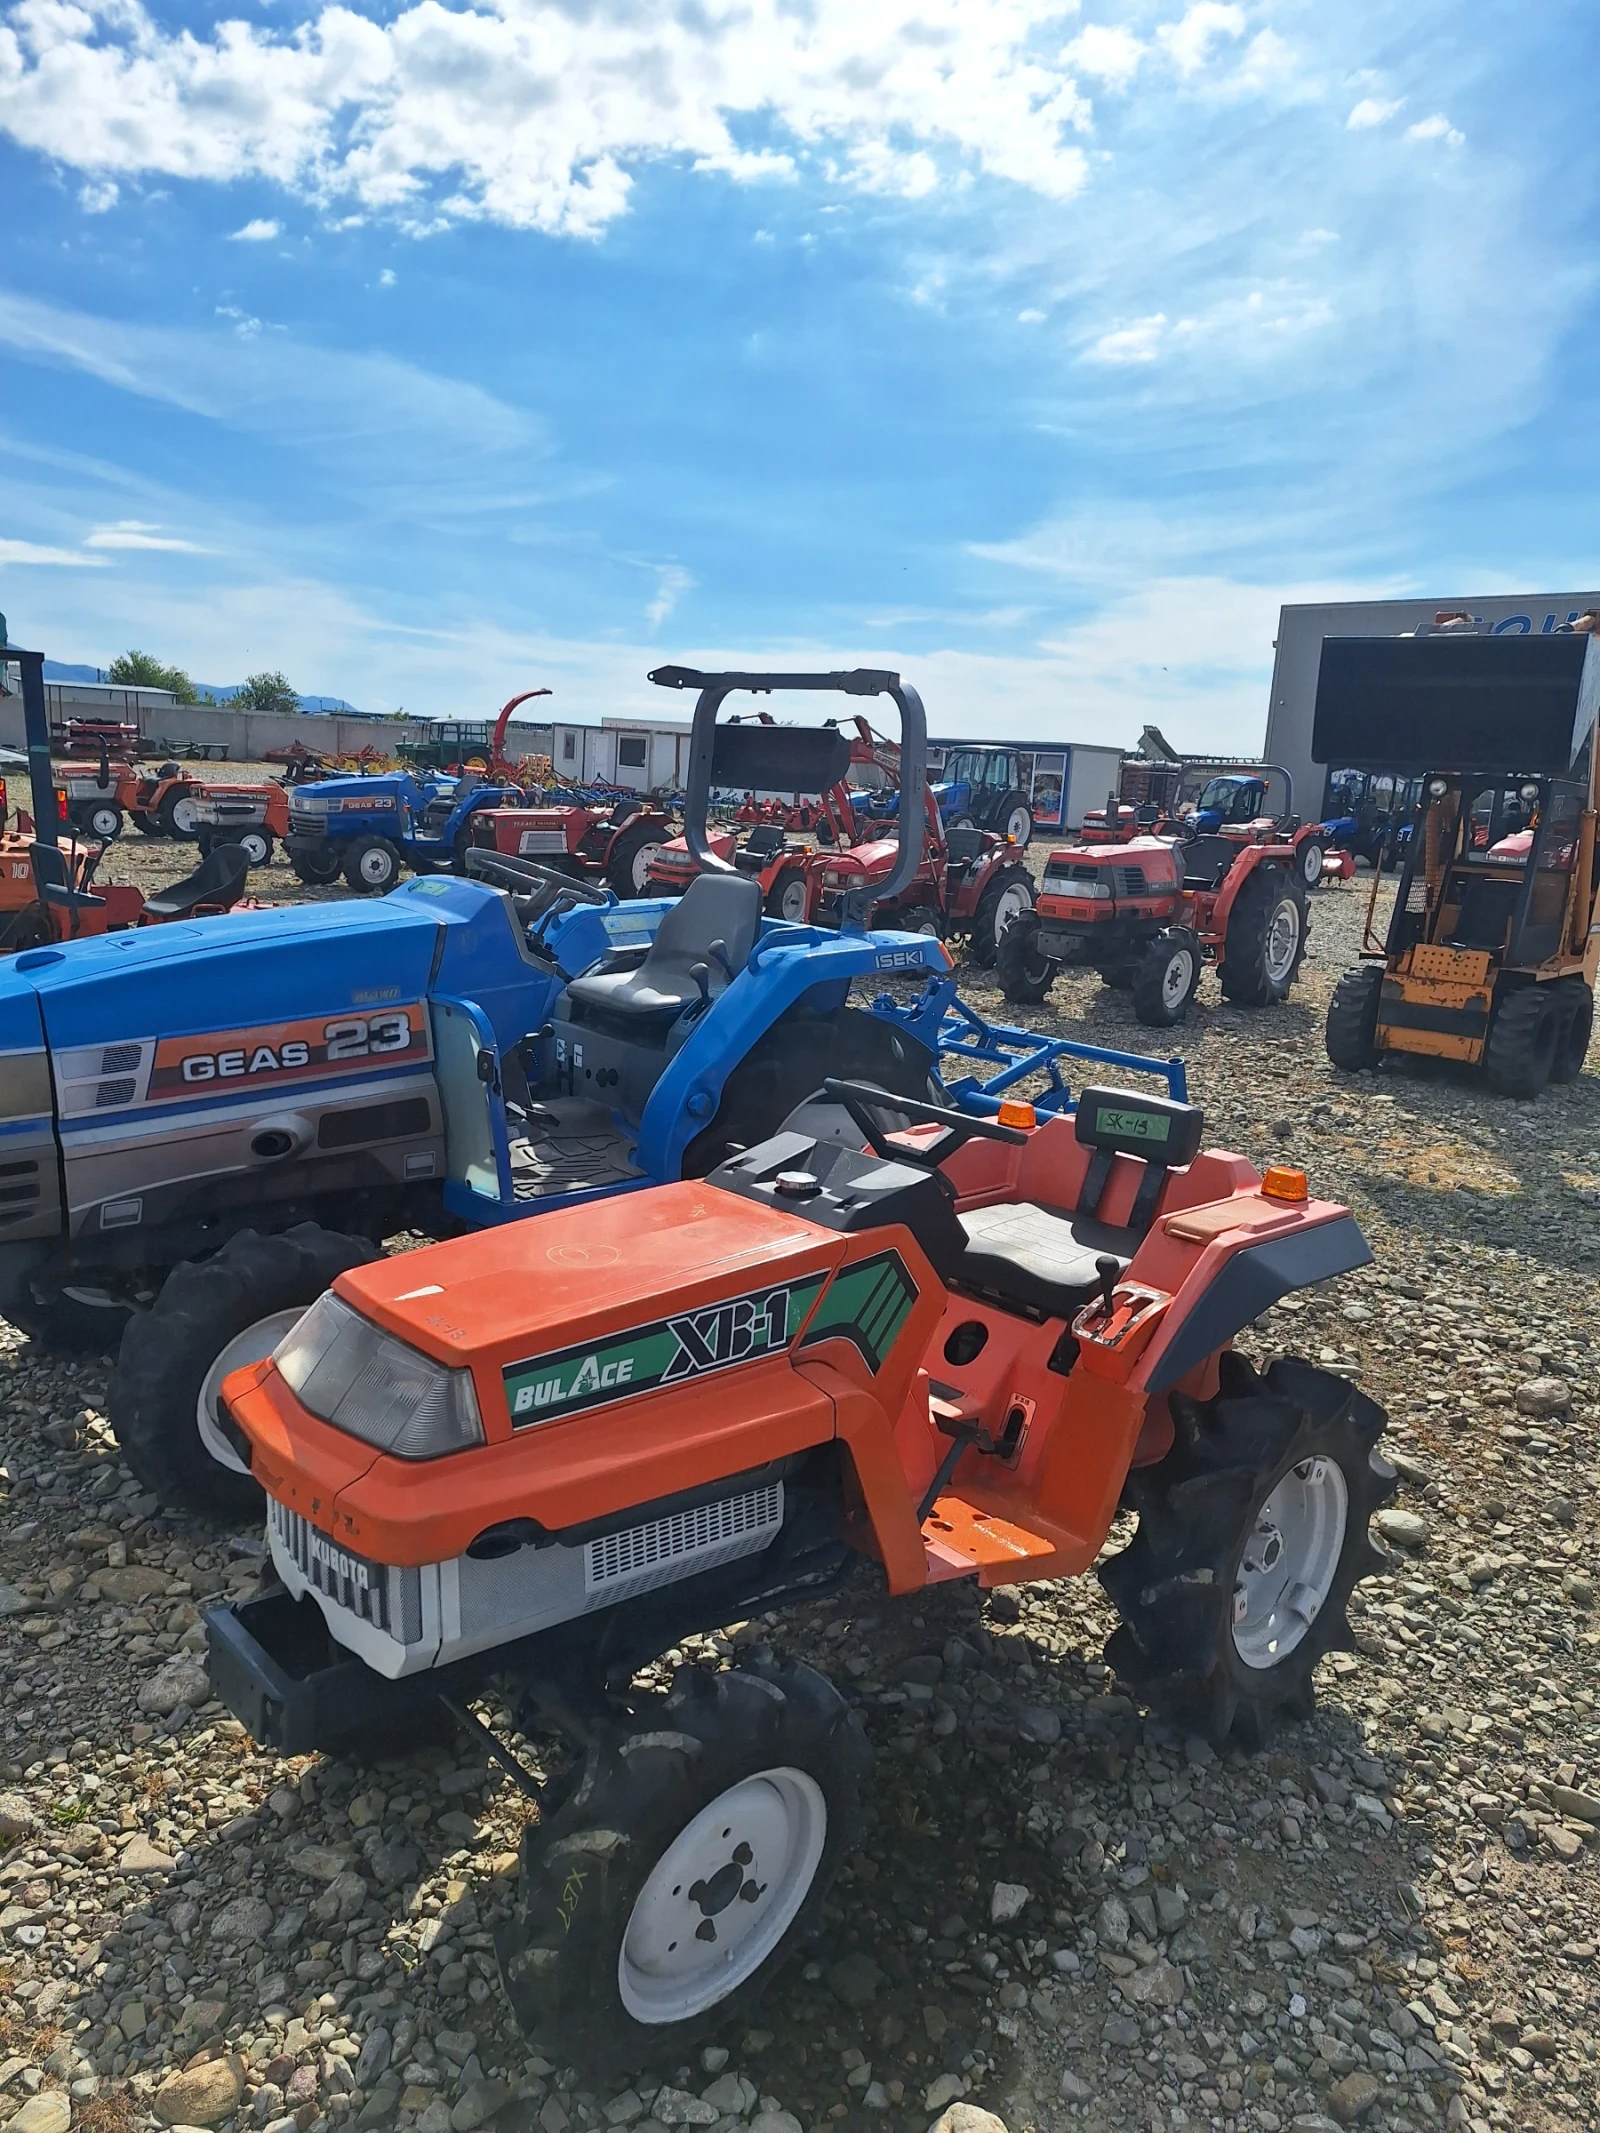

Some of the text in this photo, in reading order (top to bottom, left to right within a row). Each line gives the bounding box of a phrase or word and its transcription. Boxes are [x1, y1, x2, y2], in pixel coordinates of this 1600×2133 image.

[347, 798, 392, 809] GEAS 23
[12, 862, 29, 879] 10
[875, 949, 924, 969] ISEKI
[181, 1011, 412, 1084] GEAS 23
[514, 1287, 791, 1413] BULACE XB-1
[311, 1533, 370, 1590] KUBOTA
